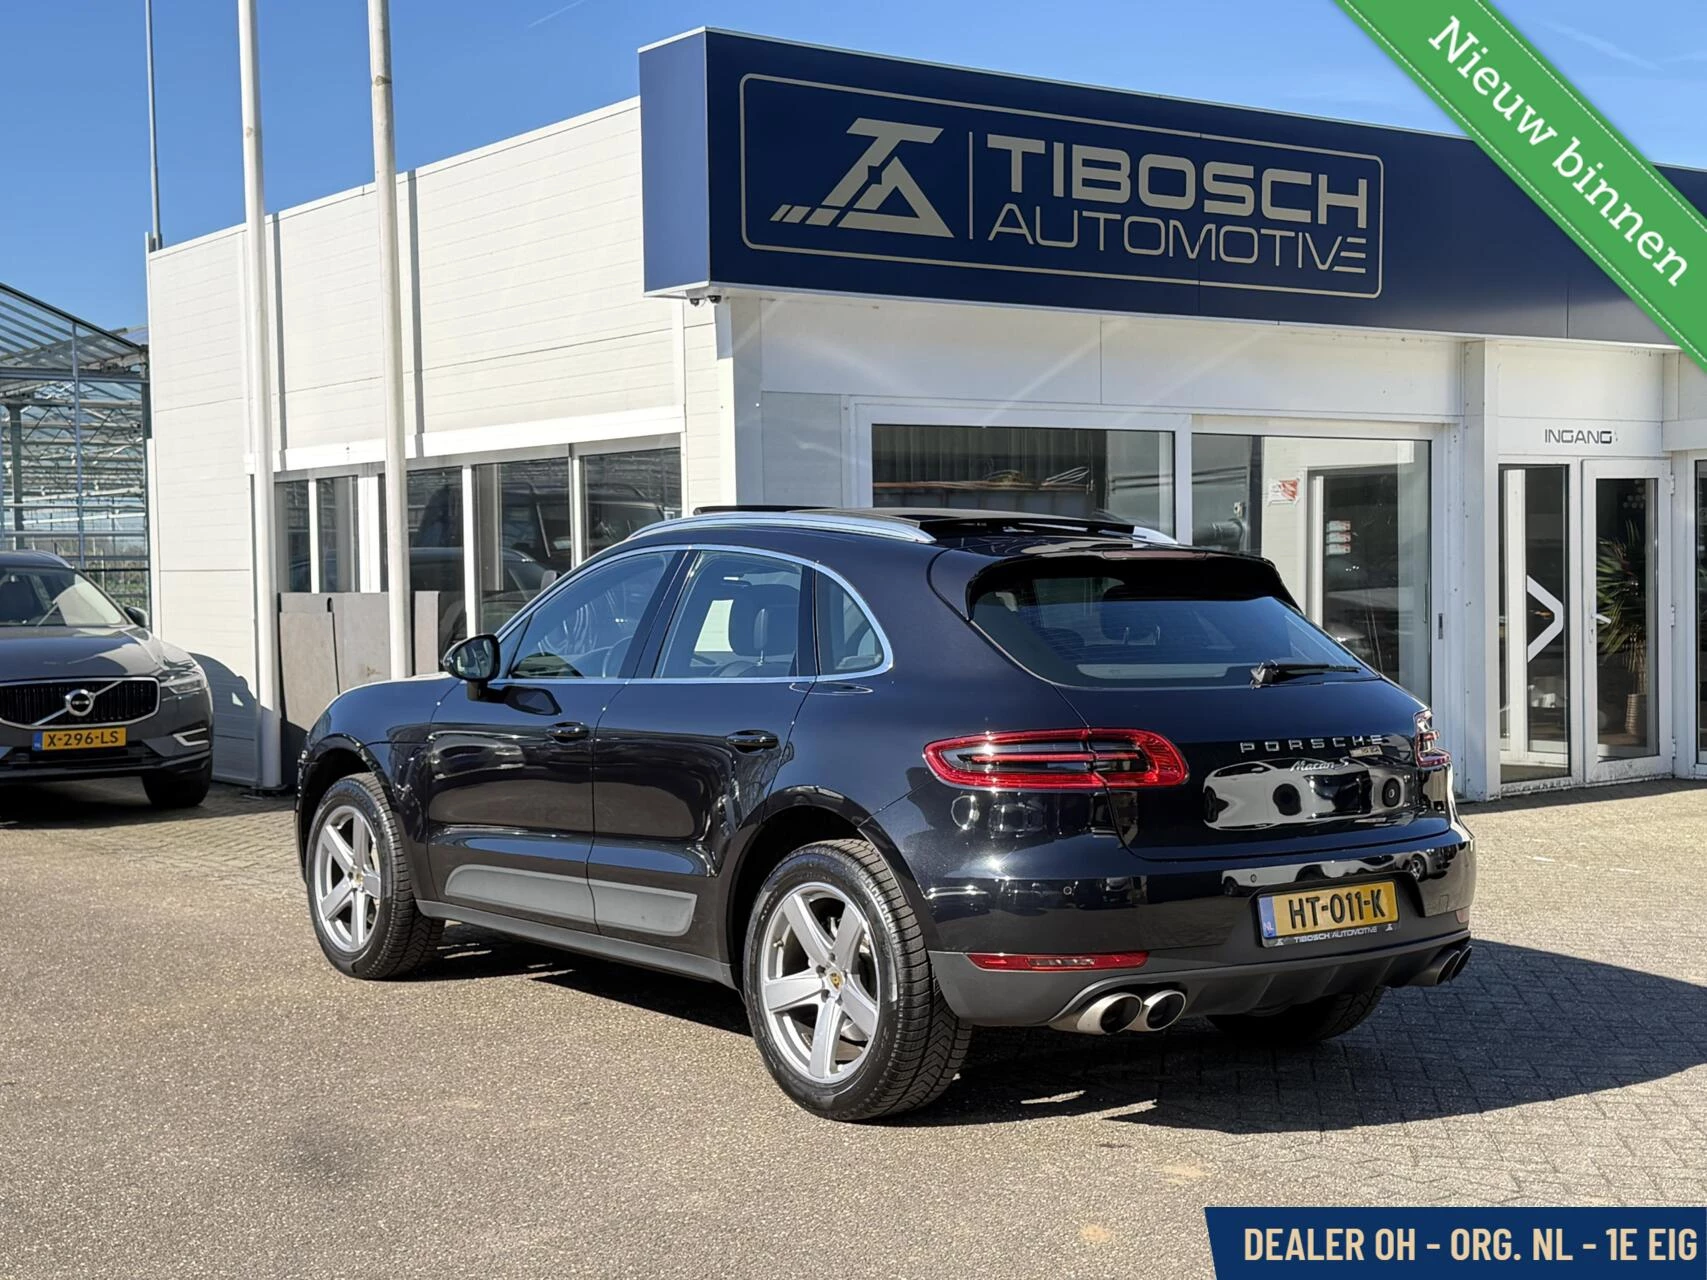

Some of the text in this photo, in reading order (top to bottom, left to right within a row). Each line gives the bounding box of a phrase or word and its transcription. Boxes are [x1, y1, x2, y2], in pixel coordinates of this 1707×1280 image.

[987, 134, 1367, 228] TIBOSCH
[988, 203, 1366, 274] AUTOMOTIVE
[1544, 428, 1612, 444] INGANG
[47, 730, 119, 747] X-296-LS
[1239, 734, 1383, 753] PORSCHE
[1290, 756, 1350, 772] Macan S
[1288, 889, 1386, 929] HT-011-K
[1294, 926, 1378, 943] TIBOSCH AUTOMOTIVE
